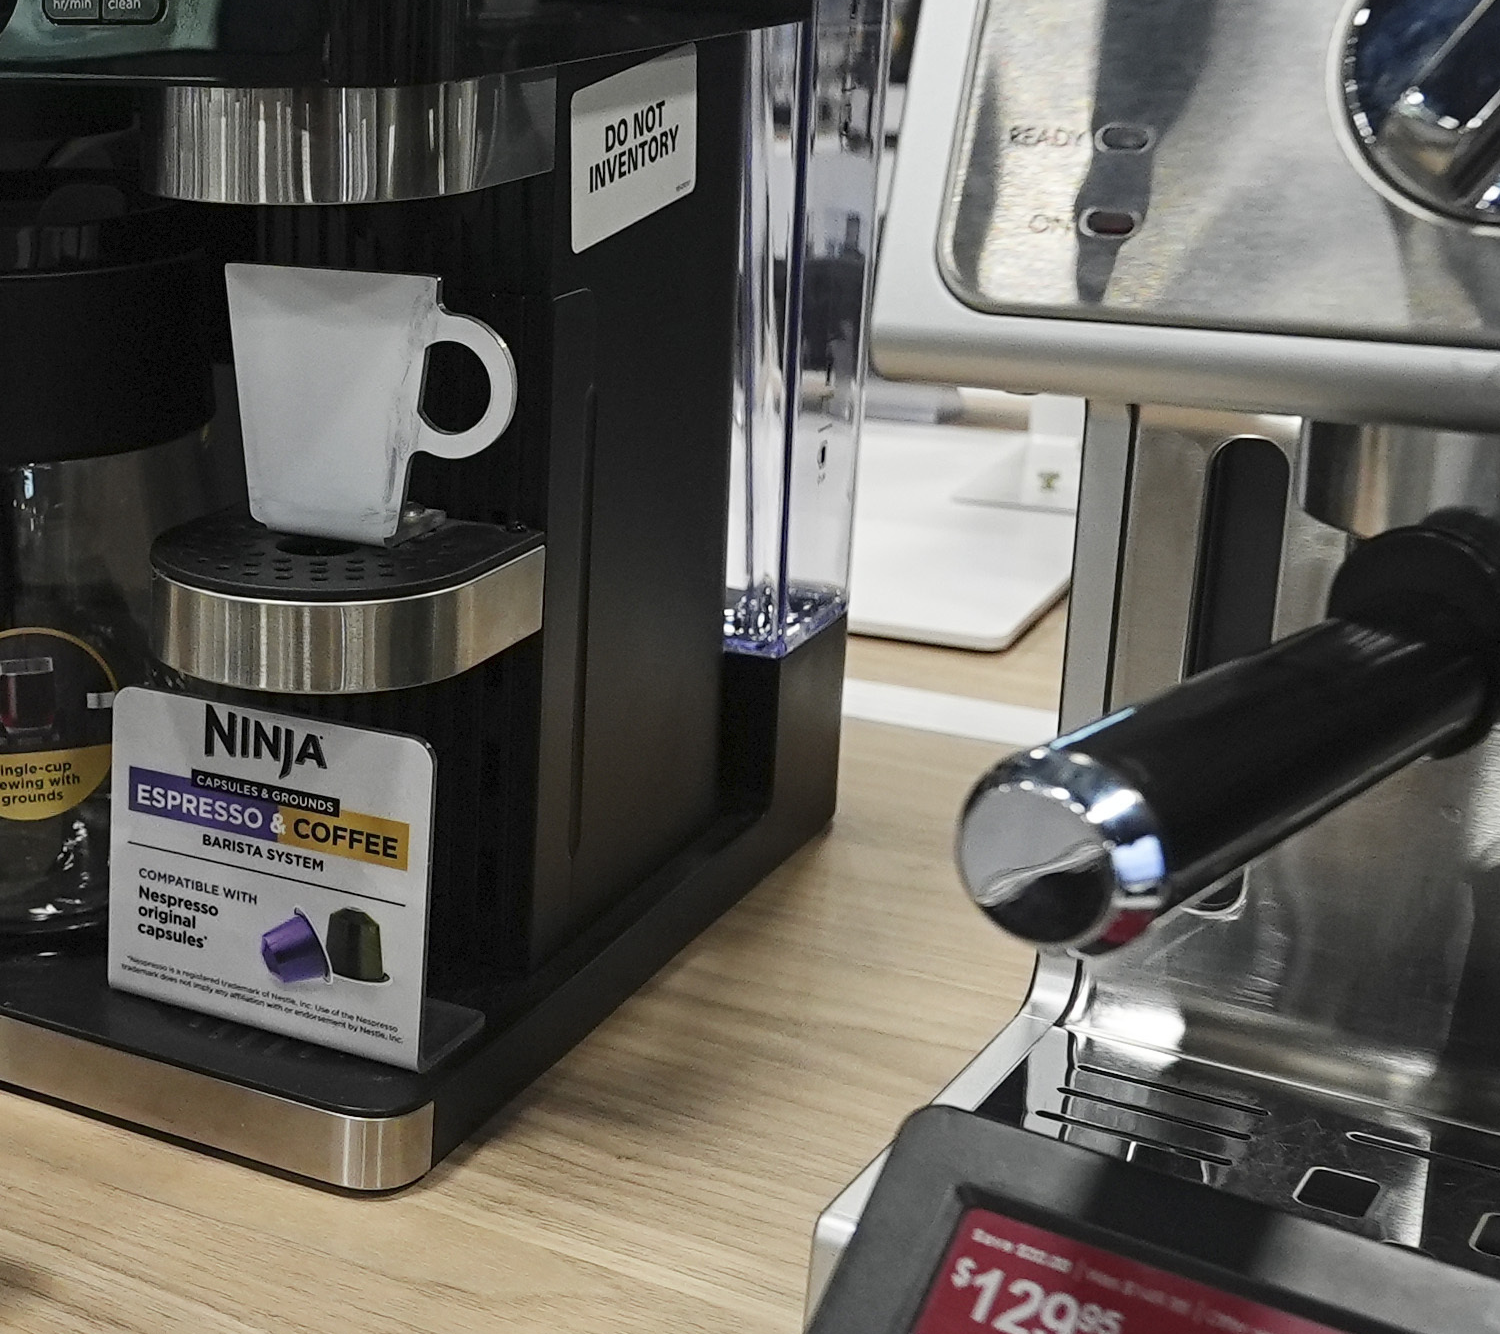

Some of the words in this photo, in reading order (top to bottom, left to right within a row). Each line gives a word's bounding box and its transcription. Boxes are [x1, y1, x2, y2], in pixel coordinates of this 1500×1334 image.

[605, 118, 628, 153] DO
[634, 100, 665, 139] NOT
[589, 124, 679, 194] INVENTORY
[204, 703, 327, 780] NINJA
[1, 789, 64, 807] grounds
[48, 773, 81, 788] with
[196, 775, 258, 797] CAPSULES
[261, 788, 269, 799] &
[272, 791, 333, 813] GROUNDS
[137, 783, 263, 829] ESPRESSO
[270, 813, 286, 835] &
[294, 818, 398, 859] COFFEE
[202, 834, 263, 859] BARISTA
[267, 849, 324, 872] SYSTEM
[139, 867, 219, 897] COMPATIBLE
[223, 886, 258, 906] WITH
[139, 885, 218, 917] Nespresso
[138, 904, 196, 929] original
[315, 1004, 330, 1015] Use
[356, 1013, 399, 1033] Nespresso
